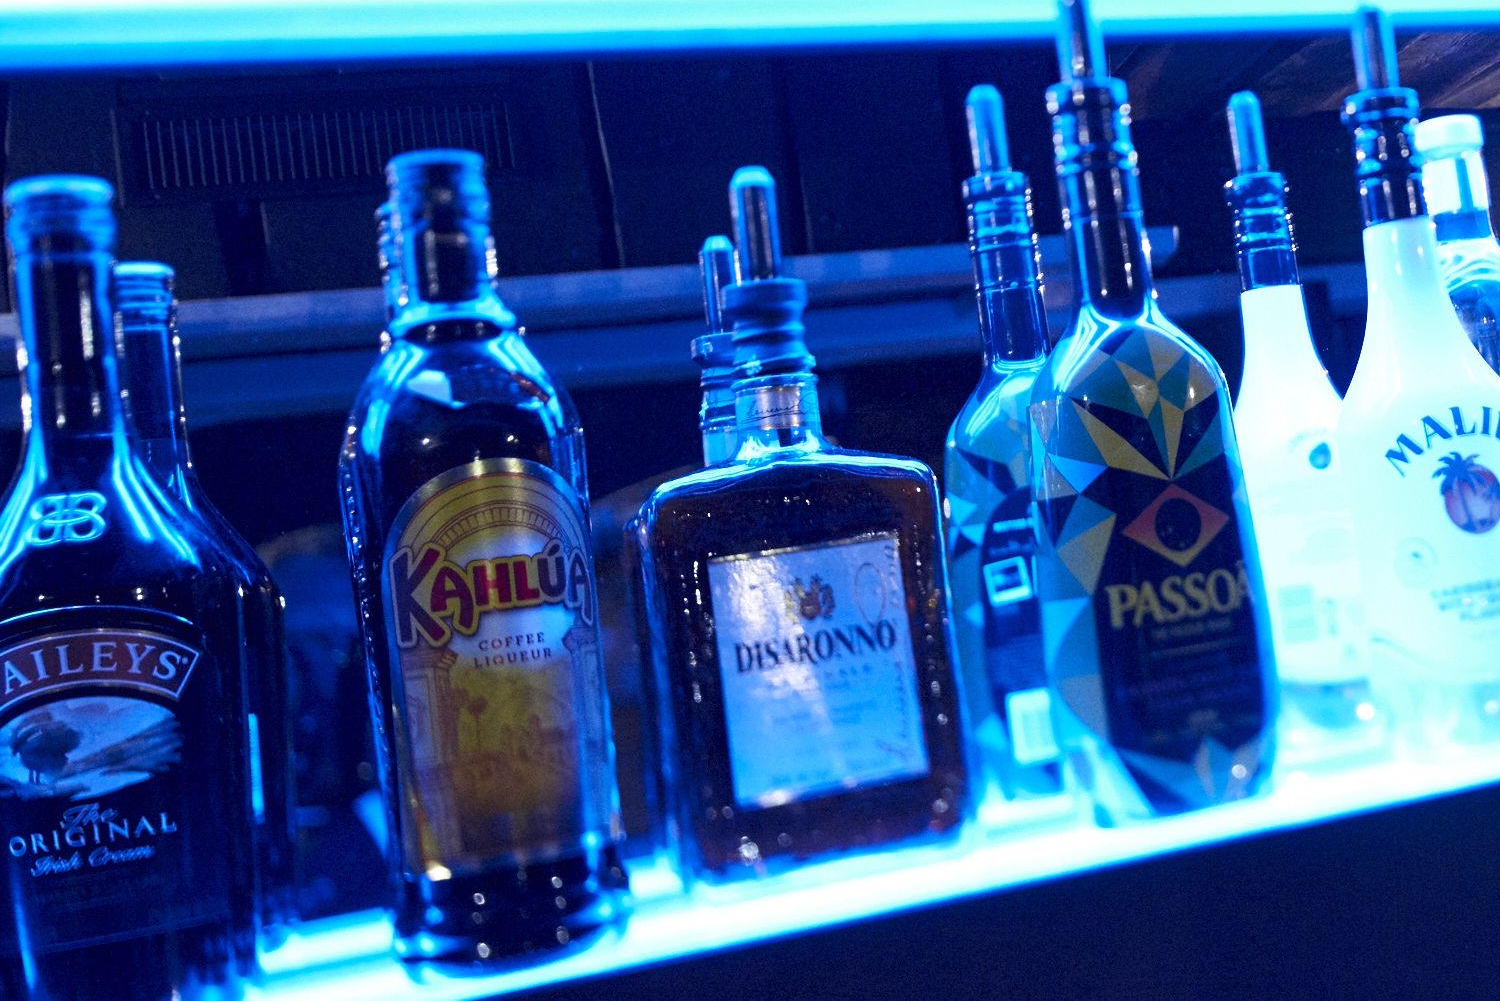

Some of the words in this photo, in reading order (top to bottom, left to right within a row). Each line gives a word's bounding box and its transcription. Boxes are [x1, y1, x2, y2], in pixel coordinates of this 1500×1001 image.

[389, 536, 594, 648] KAHLÚA
[478, 631, 545, 651] COFFEE
[736, 619, 896, 674] DISARONNO
[474, 648, 552, 669] LIQUEUR
[60, 802, 119, 830] The
[9, 811, 178, 858] ORIGINAL
[31, 851, 83, 877] Irish
[88, 846, 156, 867] Cream
